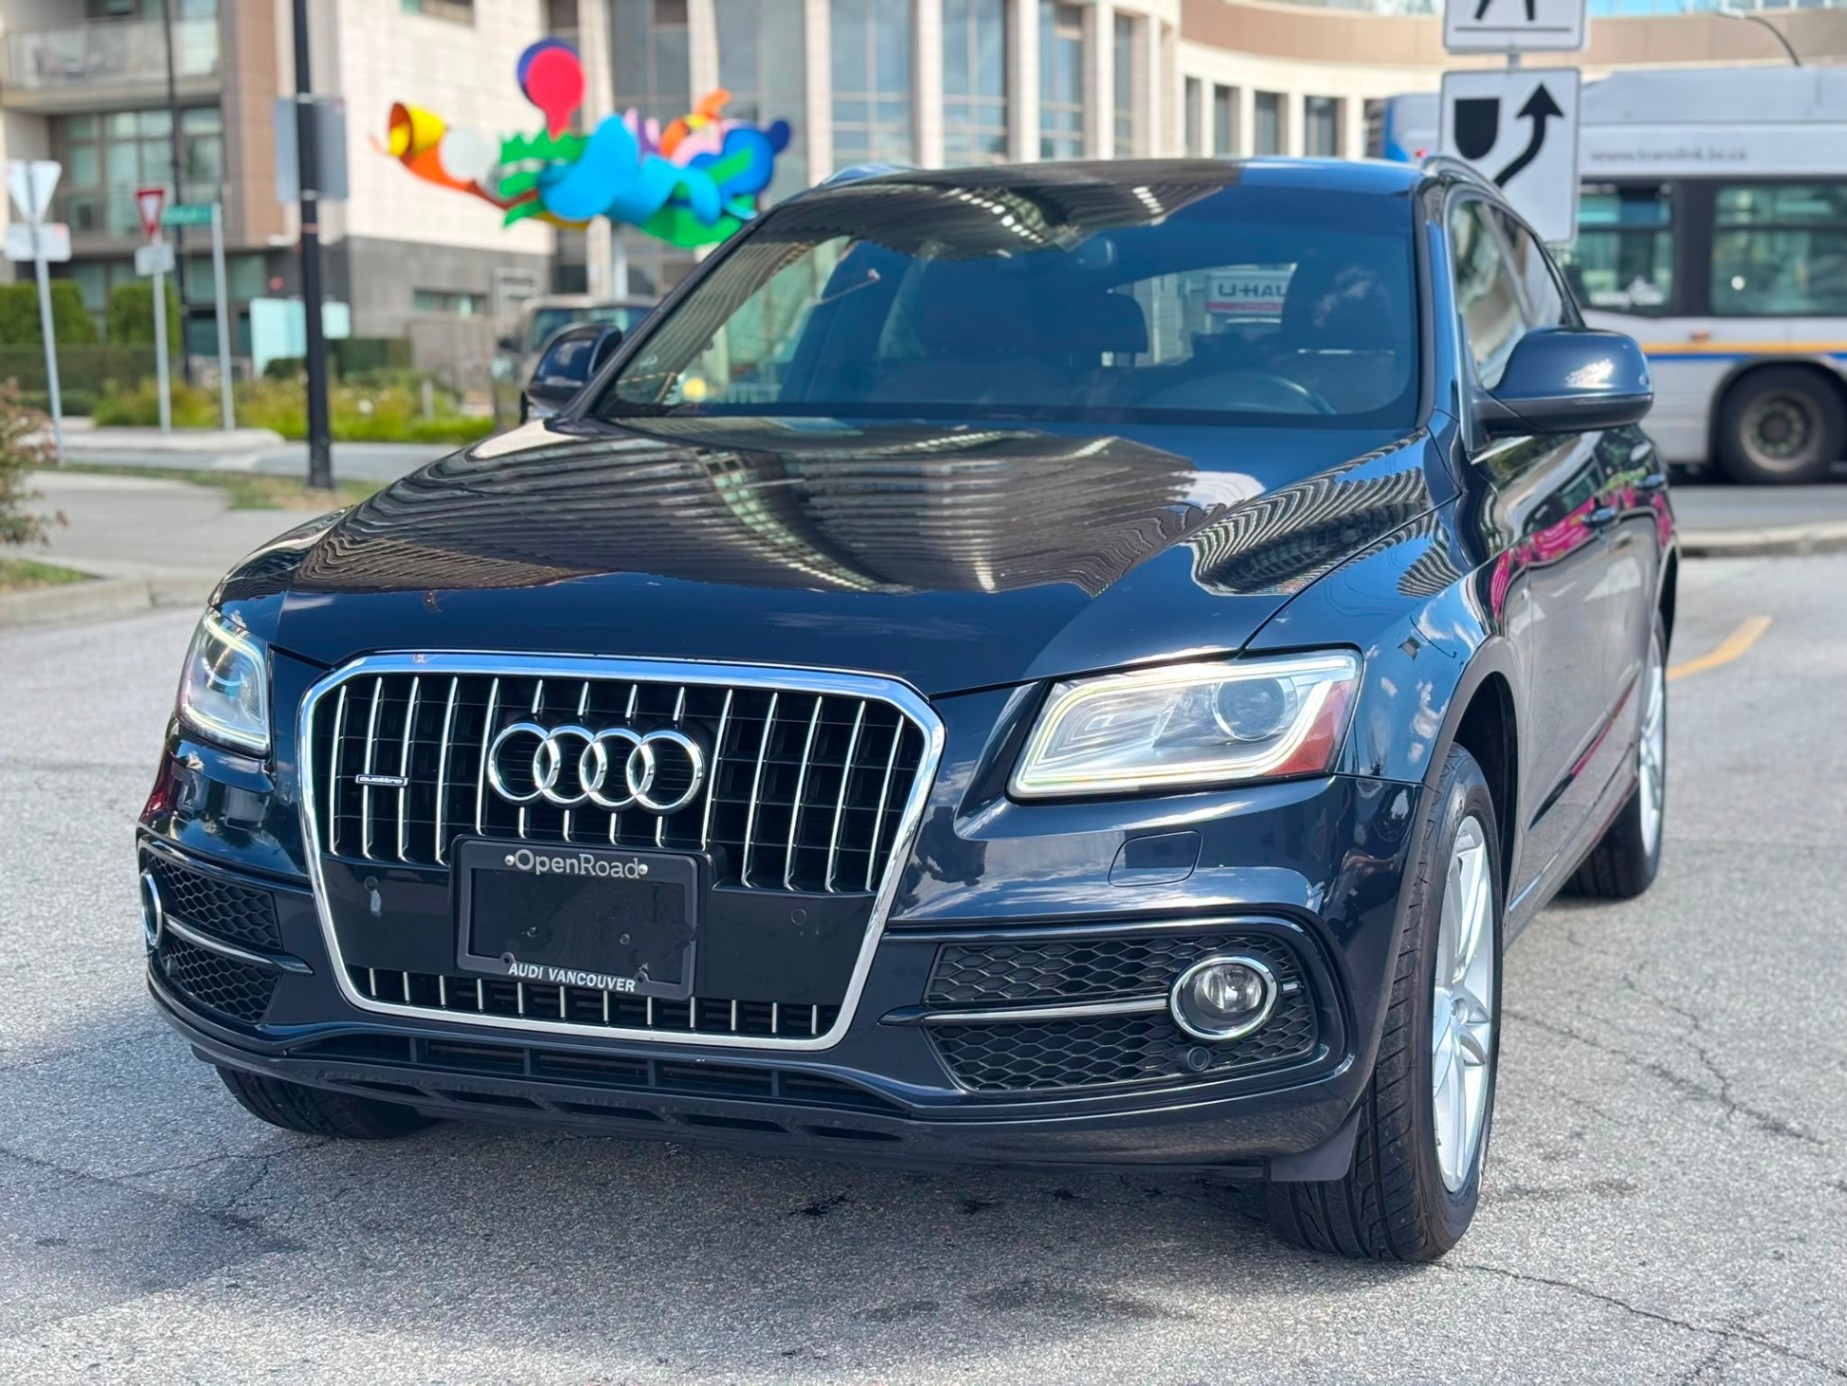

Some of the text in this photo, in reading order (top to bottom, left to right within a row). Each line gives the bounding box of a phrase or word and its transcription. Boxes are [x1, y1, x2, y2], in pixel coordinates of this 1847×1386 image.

[1218, 283, 1286, 297] U-HAU
[514, 849, 640, 879] OpenRoad
[508, 962, 636, 992] AUDI VANCOUVER
